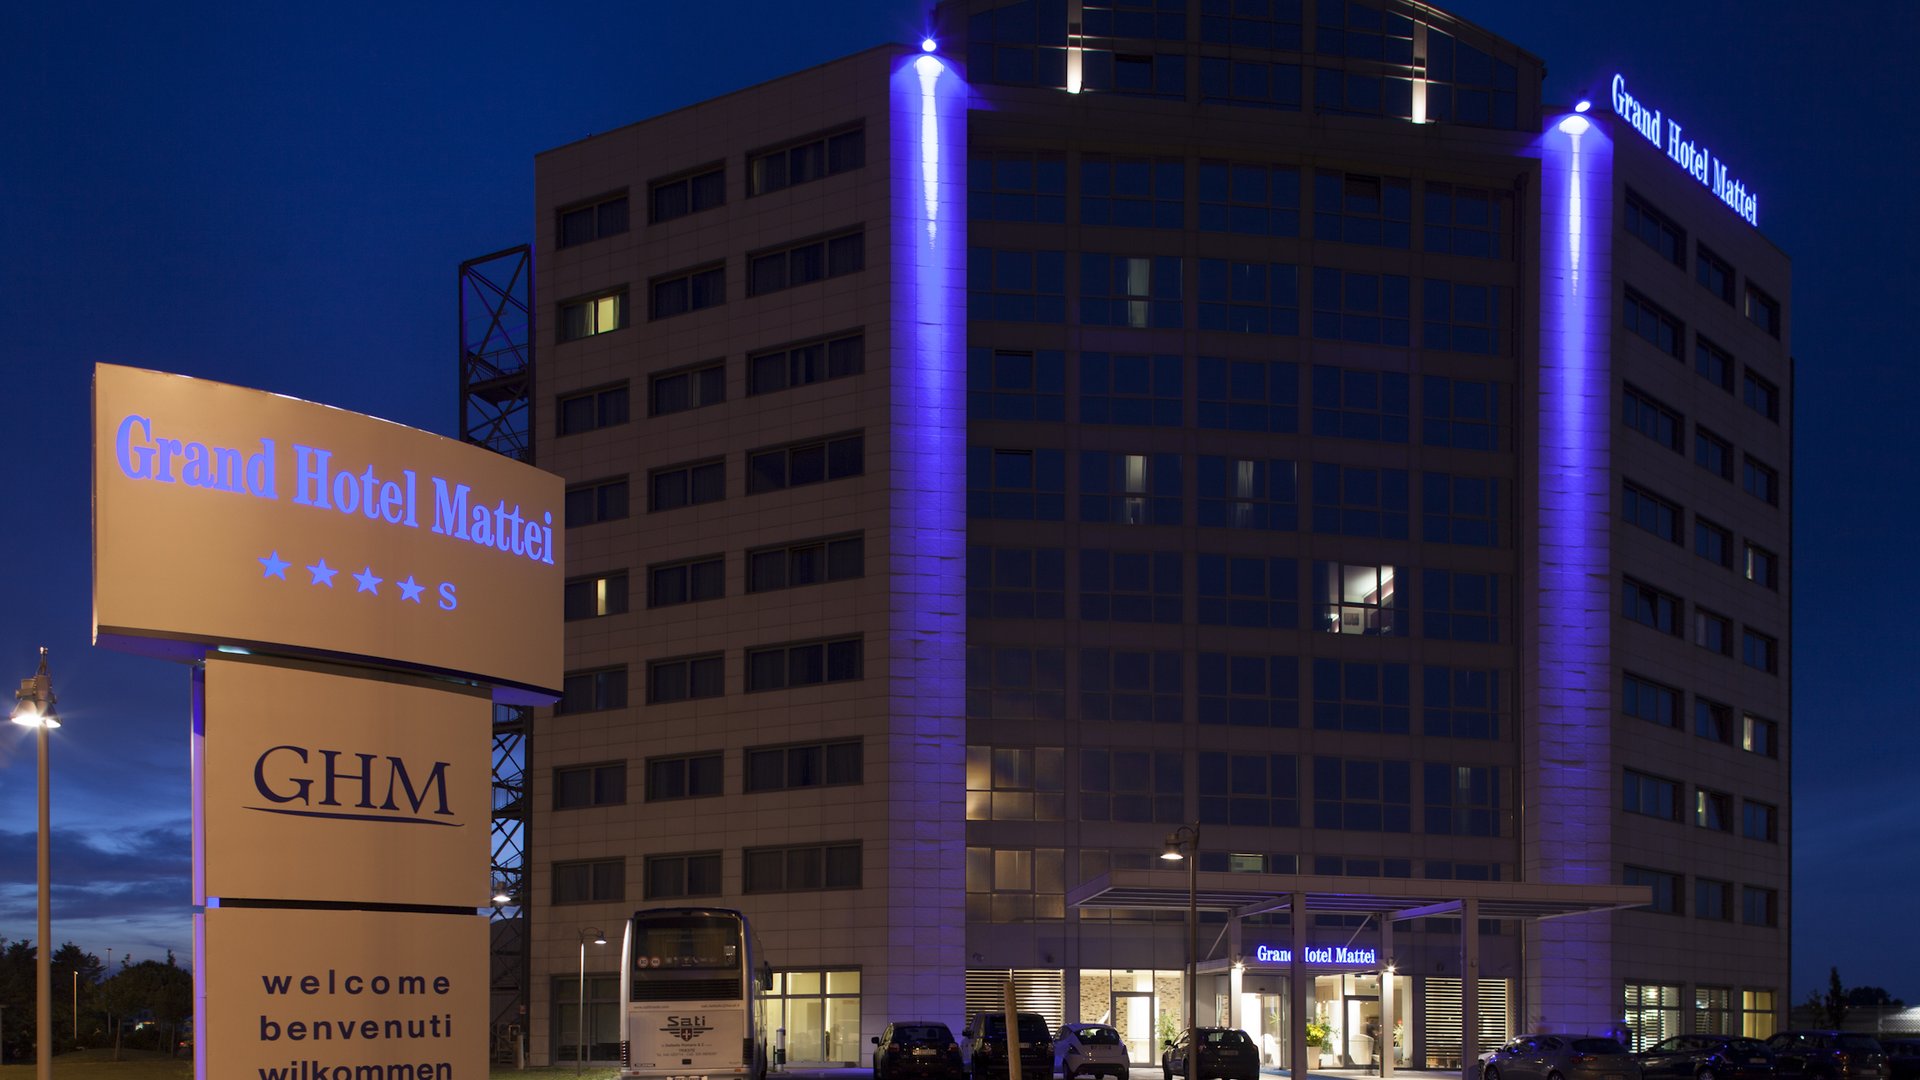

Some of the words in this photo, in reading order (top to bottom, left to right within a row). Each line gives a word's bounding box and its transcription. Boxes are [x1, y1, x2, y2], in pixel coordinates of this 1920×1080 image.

[1612, 73, 1661, 149] Grand
[1667, 118, 1708, 186] Hotel
[1712, 156, 1758, 227] Mattei
[116, 414, 278, 500] Grand
[293, 443, 419, 528] Hotel
[432, 476, 554, 565] Mattei
[254, 745, 455, 817] GHM
[1335, 948, 1376, 964] Mattei
[262, 969, 450, 995] welcome
[260, 1014, 451, 1041] benvenuti
[667, 1016, 706, 1027] Sati
